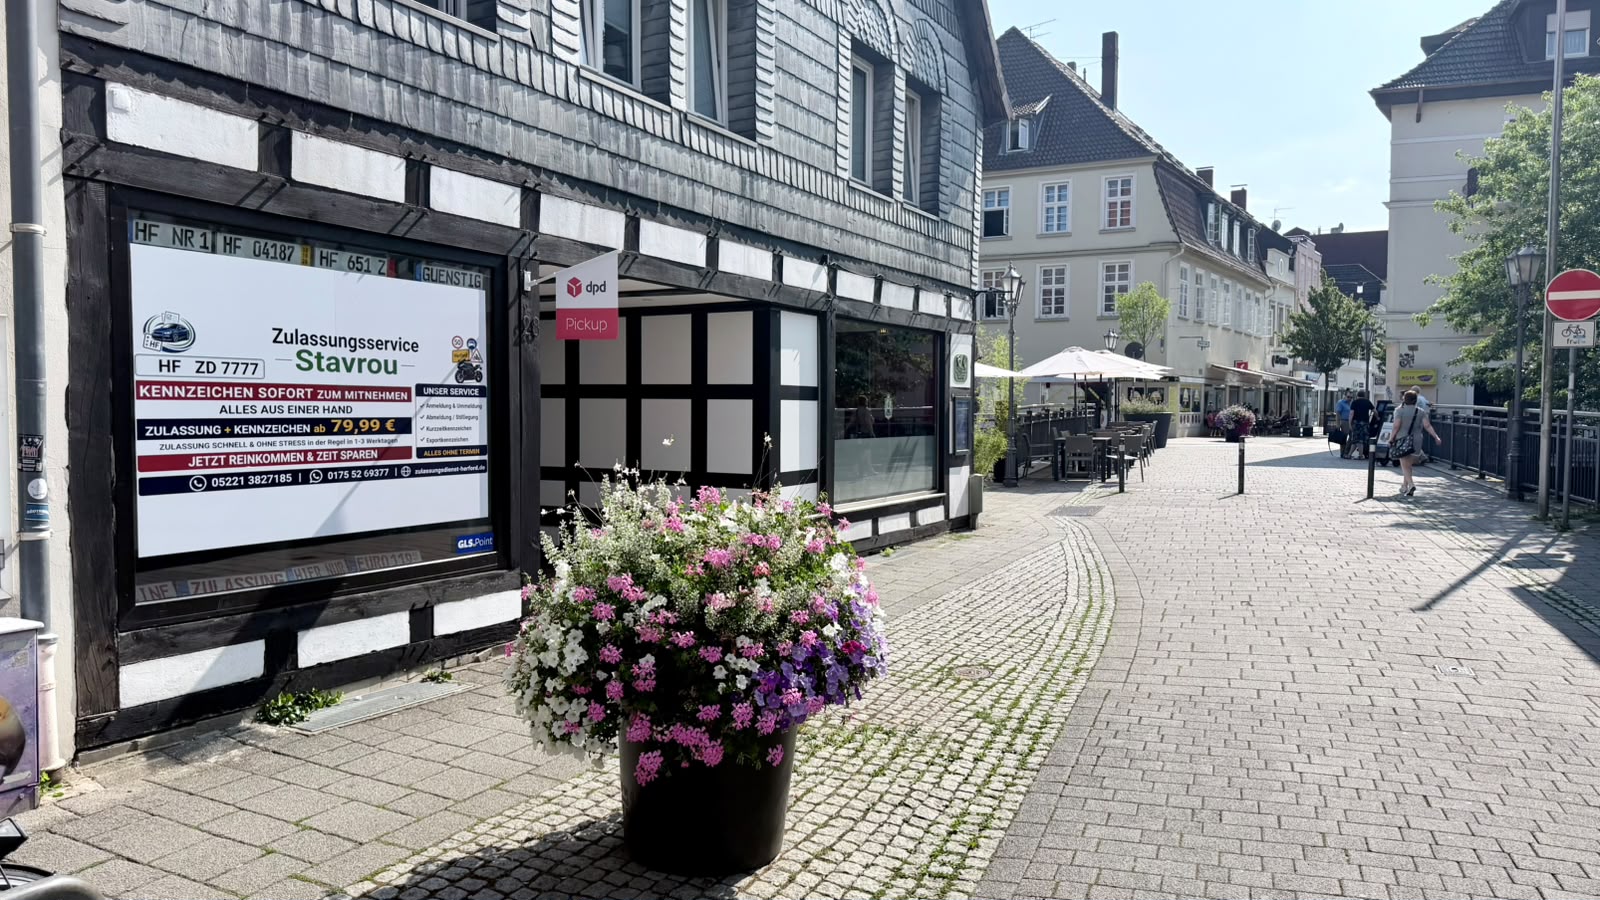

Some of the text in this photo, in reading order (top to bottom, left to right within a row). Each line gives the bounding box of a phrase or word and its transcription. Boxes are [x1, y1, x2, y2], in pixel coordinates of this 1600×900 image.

[134, 221, 209, 250] HF NR 1
[223, 236, 242, 254] HF
[253, 241, 295, 262] 04187
[319, 250, 338, 268] HF
[347, 255, 371, 273] 651
[377, 260, 386, 276] Z
[423, 266, 481, 289] GUENSTIG
[585, 281, 607, 295] dpd
[565, 317, 608, 333] Pickup
[271, 327, 419, 352] Zulassungsservice
[158, 359, 259, 376] HF ZD 7777
[295, 349, 398, 375] Stavrou
[139, 385, 408, 401] KENNZEICHEN SOFORT ZUM MITNEHMEN
[423, 387, 480, 396] UNSER SERVICE
[219, 404, 353, 415] ALLES AUS EINER HAND
[145, 418, 396, 436] ZULASSUNG + KENNZEICHEN ab 79,99 €
[159, 443, 210, 451] ZULASSUNG
[212, 441, 247, 450] SCHNELL
[256, 440, 277, 448] OHNE
[279, 439, 306, 448] STRESS
[315, 438, 326, 446] der
[327, 437, 346, 447] Regel
[347, 437, 353, 445] in
[188, 449, 378, 468] JETZT REINKOMMEN & ZEIT SPAREN
[211, 474, 292, 488] 05221 3827185
[327, 468, 389, 480] 0175 52 69377
